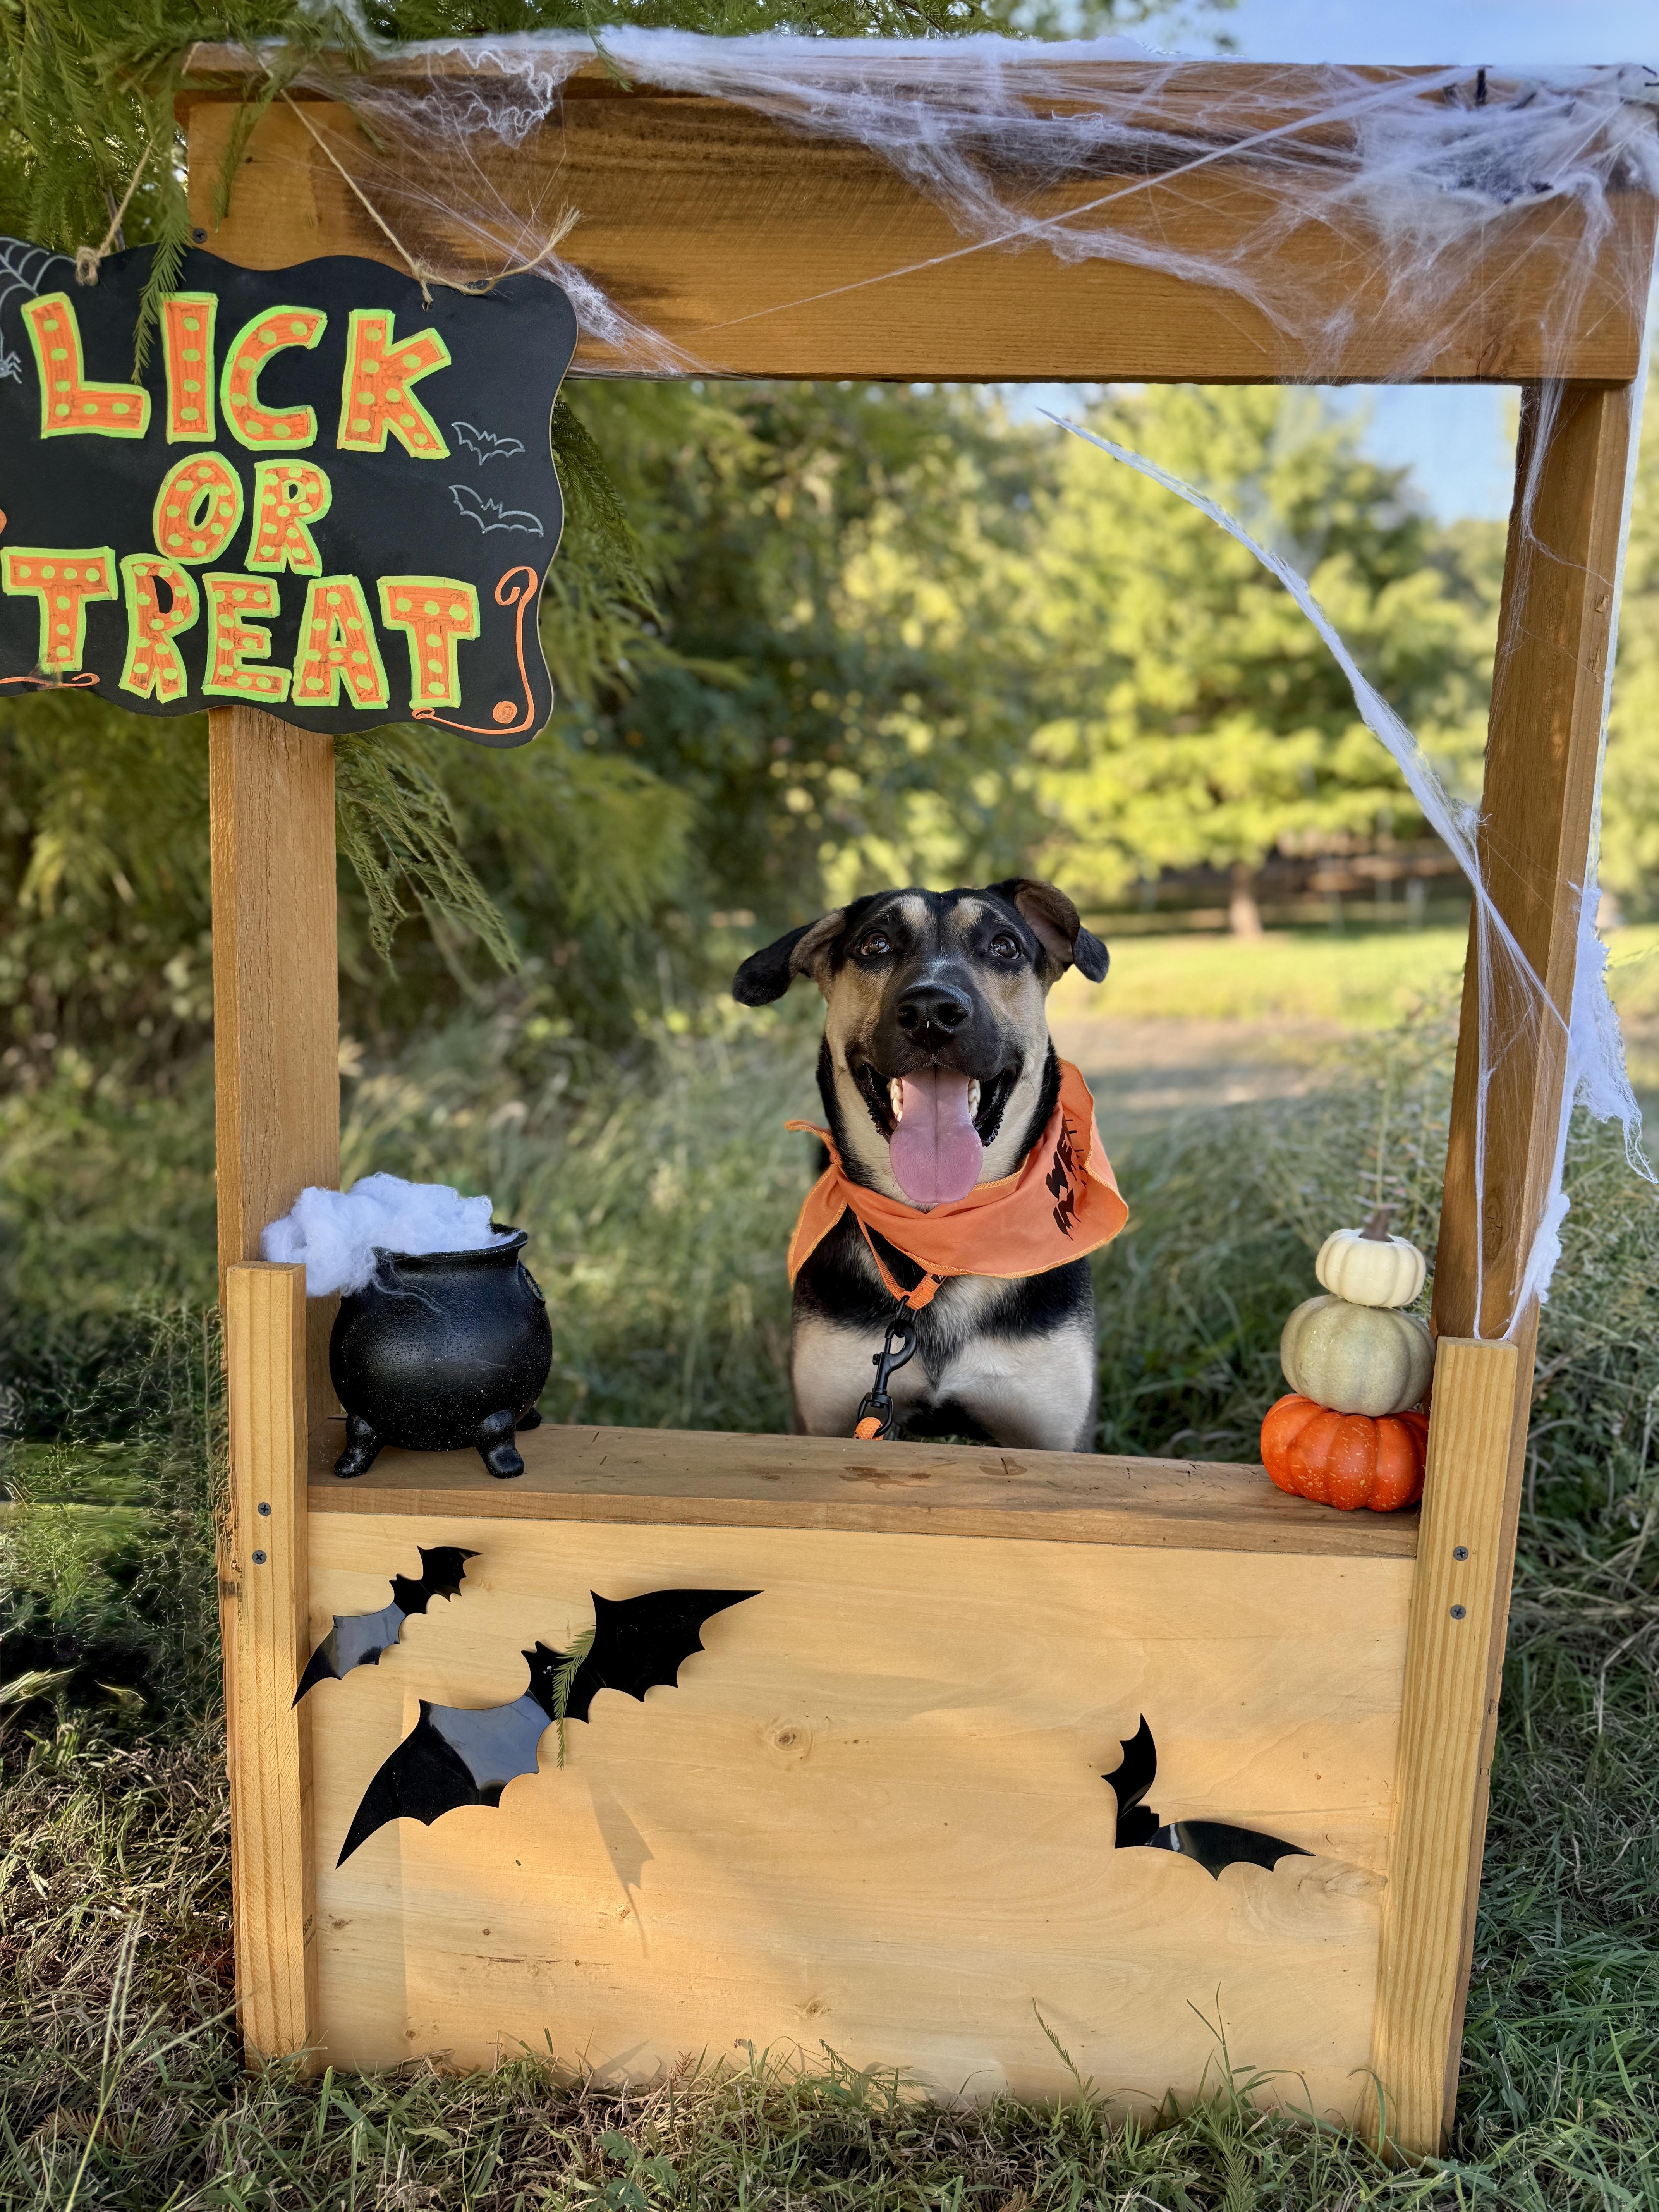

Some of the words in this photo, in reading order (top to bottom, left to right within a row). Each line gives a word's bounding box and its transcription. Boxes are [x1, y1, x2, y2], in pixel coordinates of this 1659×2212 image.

[22, 292, 451, 459] LICK
[154, 452, 332, 576] OR
[1, 547, 480, 709] TREAT
